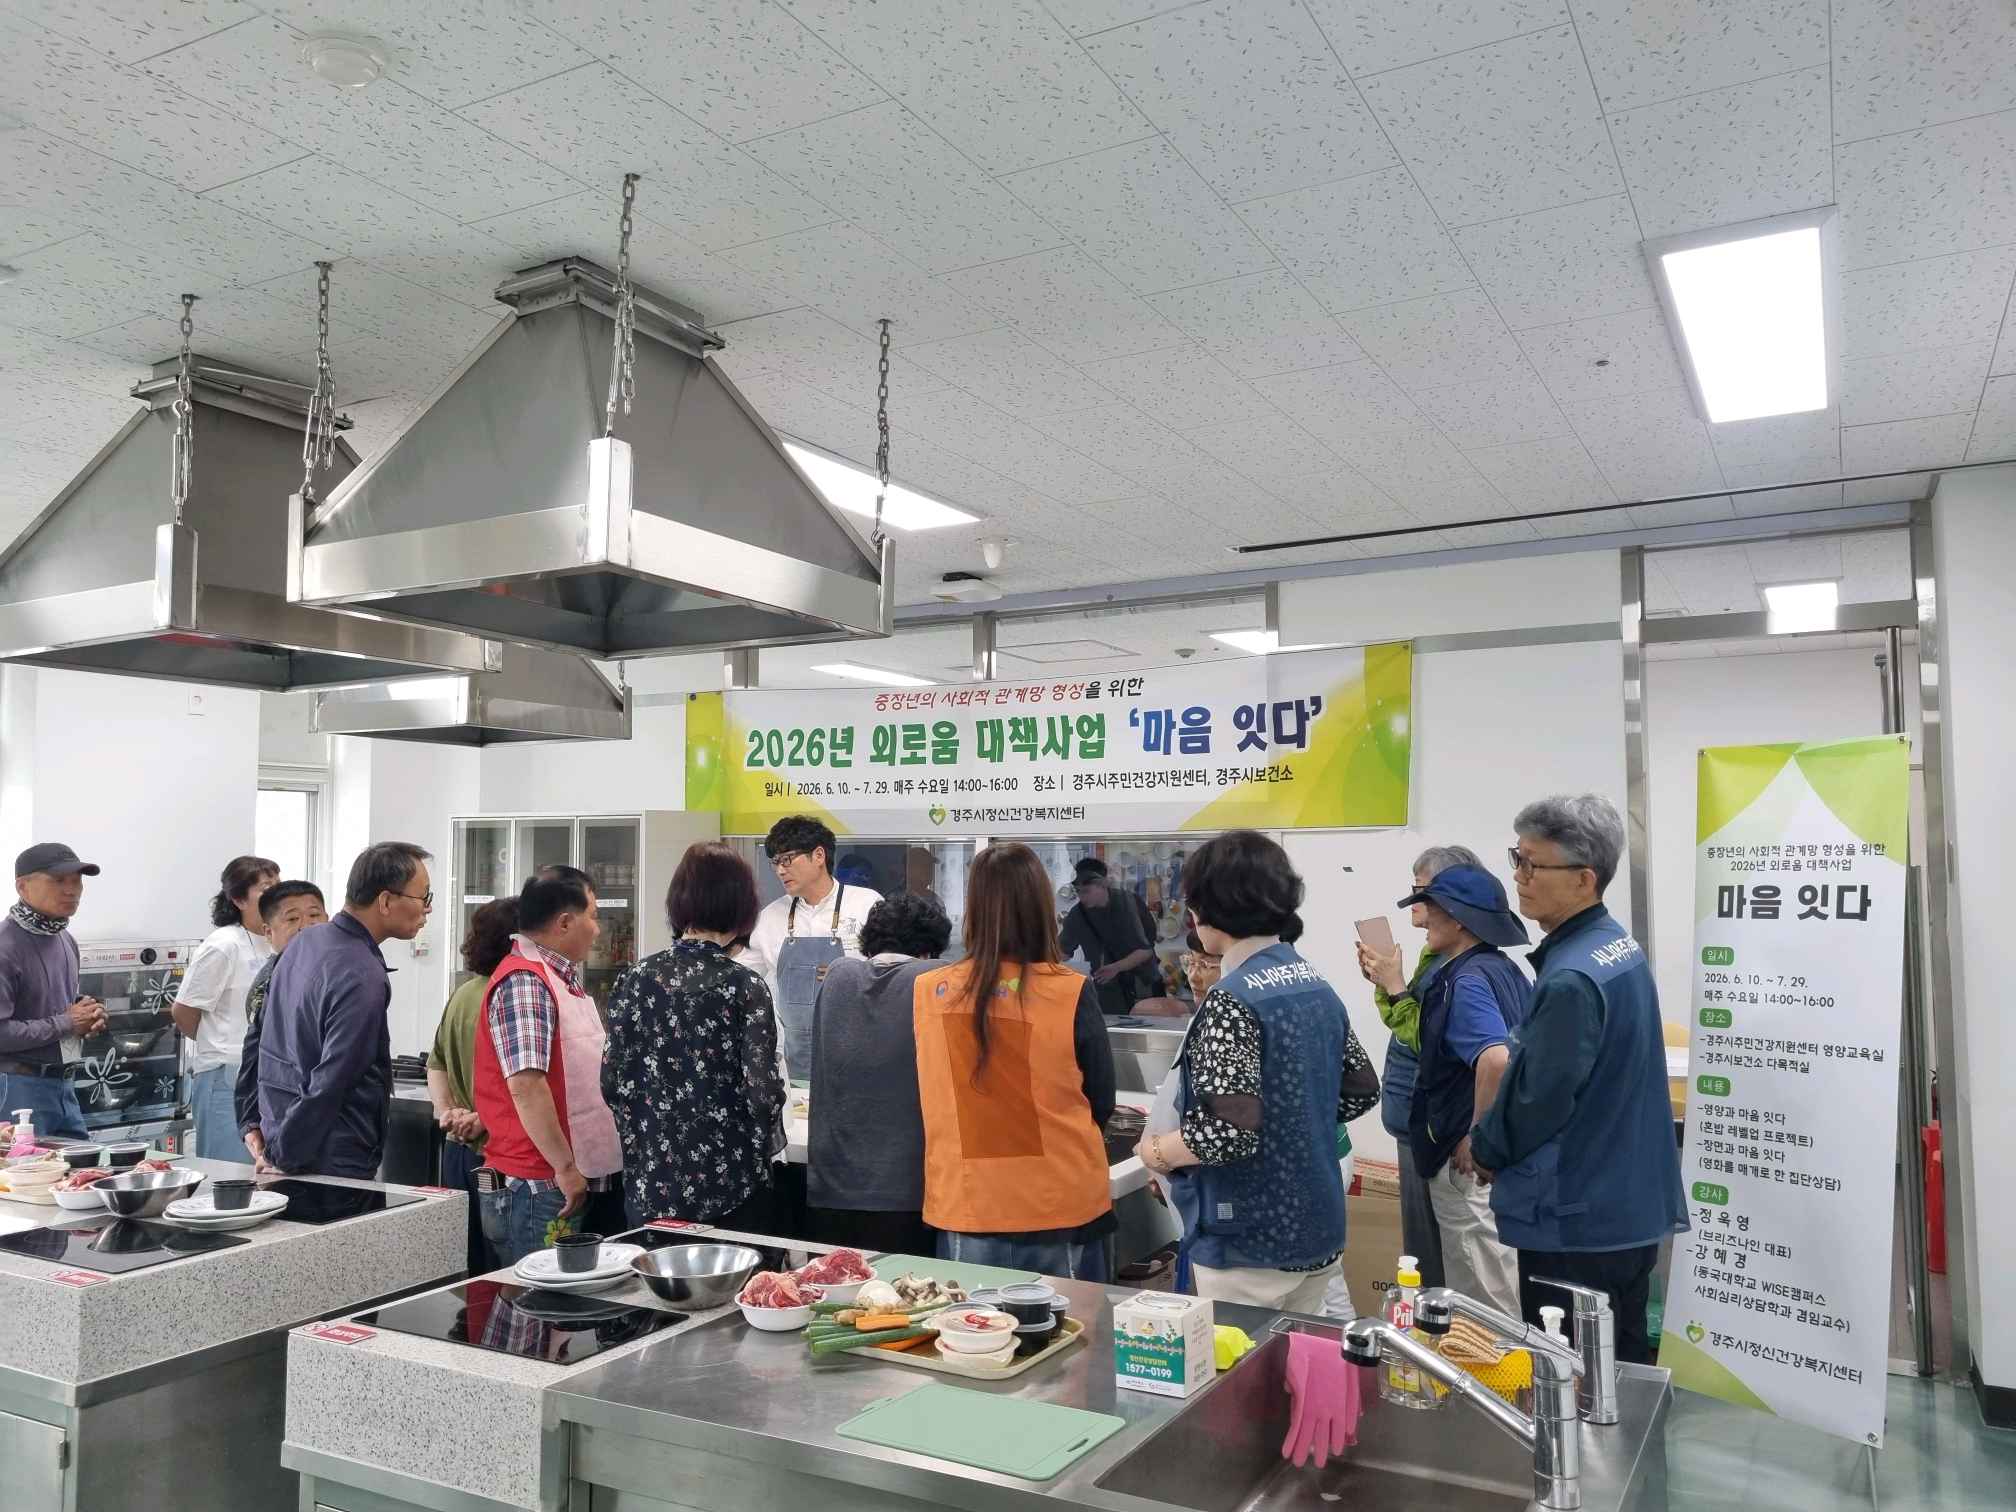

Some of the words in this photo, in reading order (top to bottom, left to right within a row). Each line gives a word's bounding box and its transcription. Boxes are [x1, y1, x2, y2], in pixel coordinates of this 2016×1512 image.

[874, 692, 936, 711] 중장년의
[941, 689, 990, 707] 사회적
[995, 686, 1046, 704] 관계망
[1051, 680, 1101, 701] 형성을
[1108, 678, 1145, 698] 위한
[746, 725, 854, 768] 2026년
[869, 720, 960, 766] 외로움
[975, 712, 1106, 763] 대책사업
[765, 781, 783, 797] 일시
[797, 782, 823, 796] 2026.
[826, 782, 835, 795] 6.
[837, 782, 851, 795] 10.
[863, 782, 872, 794] 7.
[875, 781, 890, 795] 29.
[893, 780, 915, 795] 매주
[918, 779, 949, 793] 수요일
[953, 778, 1018, 793] 14:00~16:00
[1033, 776, 1056, 792] 장소
[1072, 769, 1211, 790] 경주시주민건강지원센터,
[1216, 765, 1293, 786] 경주시보건소
[949, 806, 1085, 823] 경주시정신건강복지센터
[1706, 845, 1745, 859] 중장년의
[1749, 844, 1781, 857] 사회적
[1784, 843, 1818, 857] 관계망
[1822, 843, 1857, 857] 형성을
[1860, 843, 1886, 857] 위한
[1730, 859, 1766, 872] 2026년
[1770, 859, 1802, 872] 외로움
[1806, 858, 1852, 872] 대책사업
[1717, 884, 1781, 920] 마음
[1797, 884, 1872, 921] 잇다
[1707, 950, 1728, 962] 일시
[1704, 972, 1731, 985] 2026.
[1733, 974, 1743, 985] 6.
[1748, 974, 1763, 986] 10.
[1777, 976, 1787, 988] 7.
[1791, 976, 1809, 989] 29.
[1704, 989, 1724, 1001] 매주
[1727, 991, 1759, 1004] 수요일
[1764, 993, 1835, 1008] 14:00~16:00
[1704, 1011, 1727, 1024] 장소
[1823, 1044, 1884, 1063] 영양교육실
[1767, 1058, 1810, 1074] 다목적실
[1702, 1079, 1725, 1093] 내용
[1763, 1111, 1787, 1126] 잇다
[1727, 1125, 1760, 1141] 레벨업
[1763, 1148, 1786, 1164] 잇다
[1737, 1163, 1770, 1180] 매개로
[1774, 1169, 1785, 1183] 한
[1699, 1186, 1723, 1201] 강사
[1736, 1215, 1749, 1232] 영
[1764, 1243, 1792, 1259] 대표)
[1733, 1252, 1747, 1269] 경
[1693, 1265, 1757, 1290] (동국대학교
[1761, 1280, 1827, 1307] WISE캠퍼스
[1694, 1285, 1792, 1319] 사회심리상담학과
[1393, 1306, 1414, 1326] Pril
[1710, 1331, 1863, 1385] 경주시정신건강복지센터
[1125, 1362, 1172, 1379] 1577-0199
